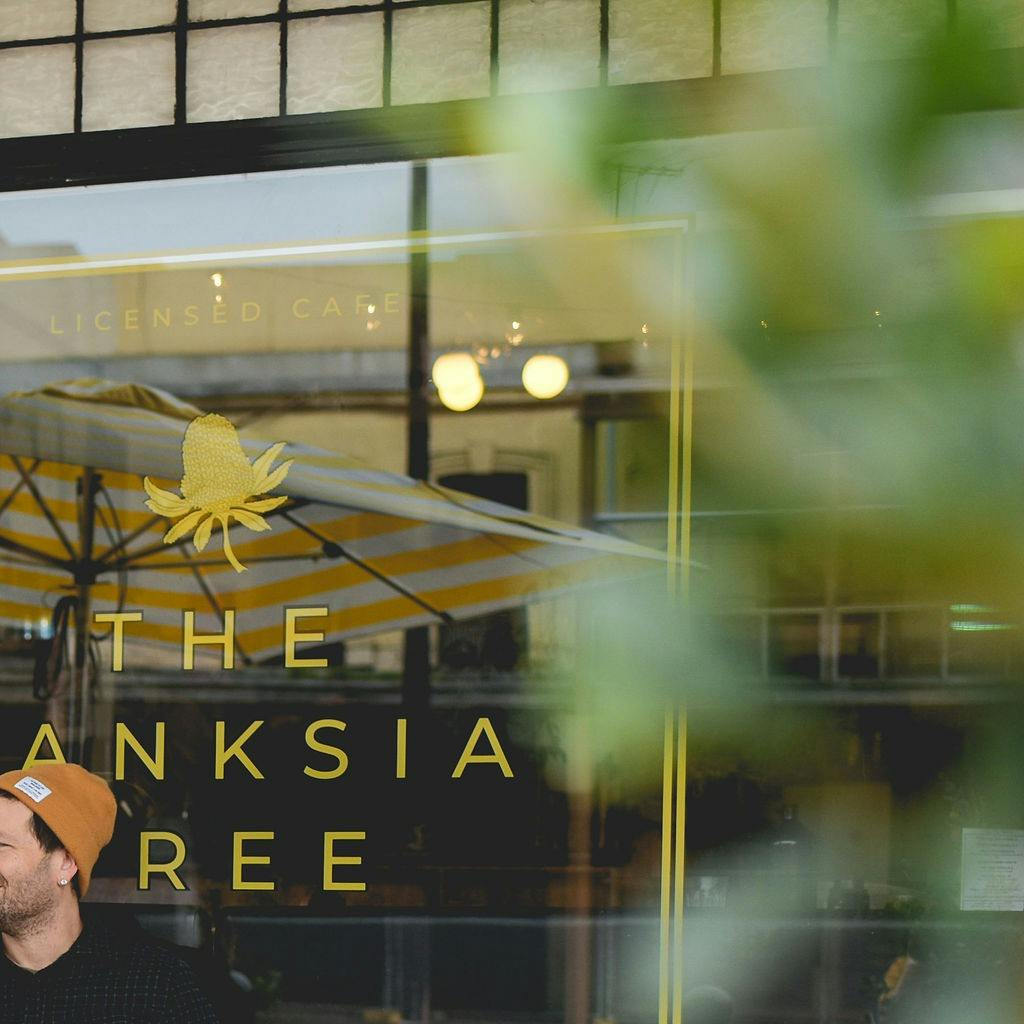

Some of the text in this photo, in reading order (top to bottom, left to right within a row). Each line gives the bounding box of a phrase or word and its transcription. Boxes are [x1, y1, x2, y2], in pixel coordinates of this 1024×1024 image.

[51, 293, 400, 335] LICENSED CAFE
[94, 606, 329, 672] THE
[139, 831, 367, 892] REE
